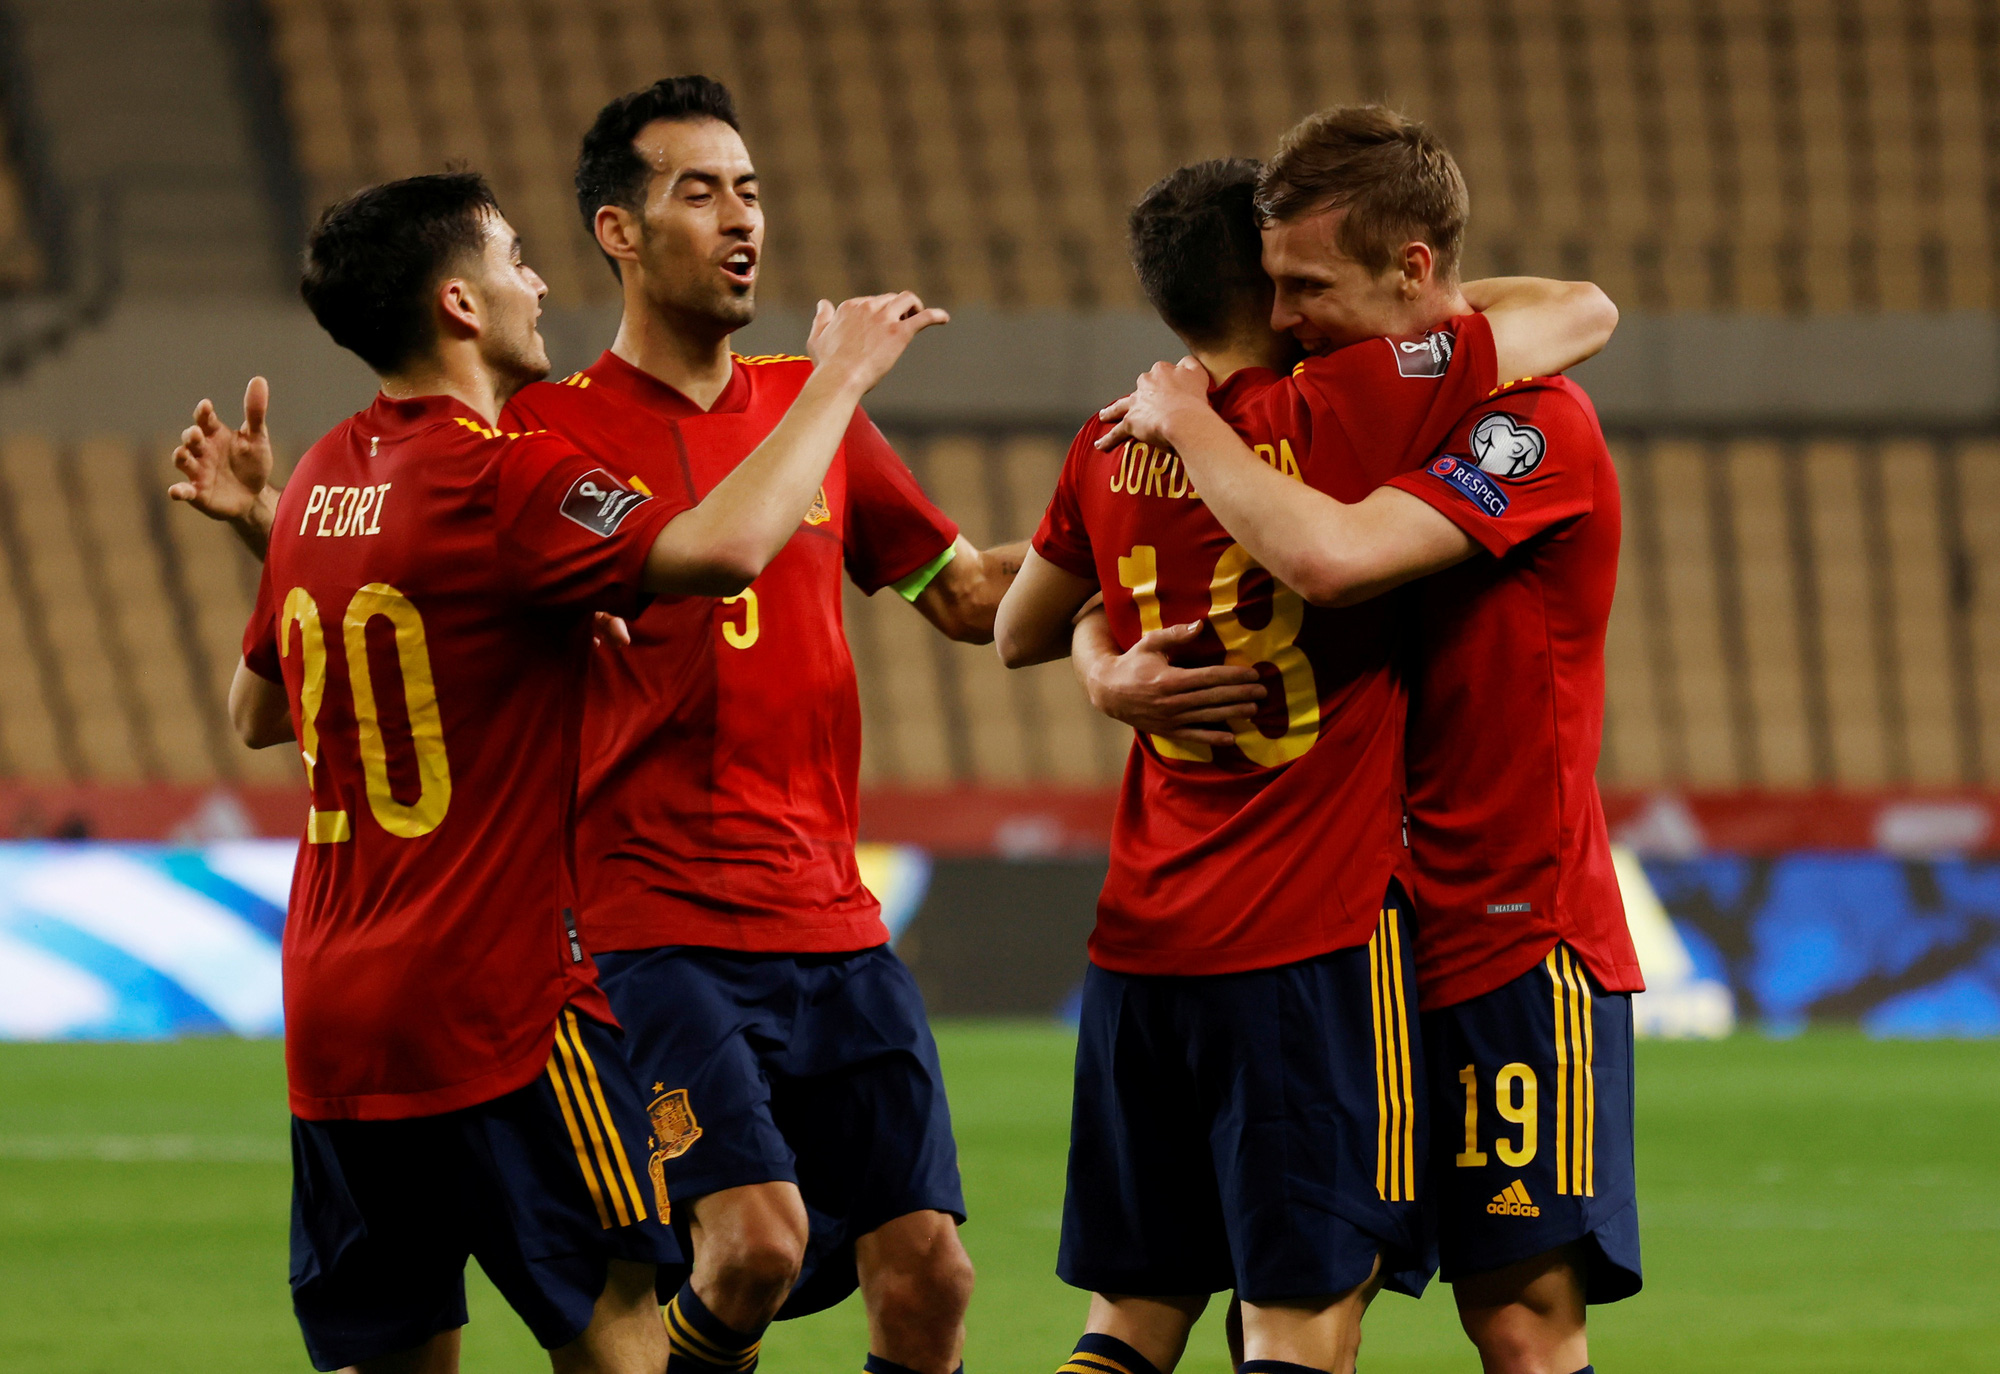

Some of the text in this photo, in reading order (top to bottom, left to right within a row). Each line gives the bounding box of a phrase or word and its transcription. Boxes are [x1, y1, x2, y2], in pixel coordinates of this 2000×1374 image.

[1110, 440, 1200, 499] JORD
[1452, 467, 1505, 516] RESPECT
[299, 482, 392, 537] PEDRI
[282, 582, 452, 844] 20
[1456, 1062, 1538, 1167] 19
[1486, 1201, 1540, 1218] adidas
